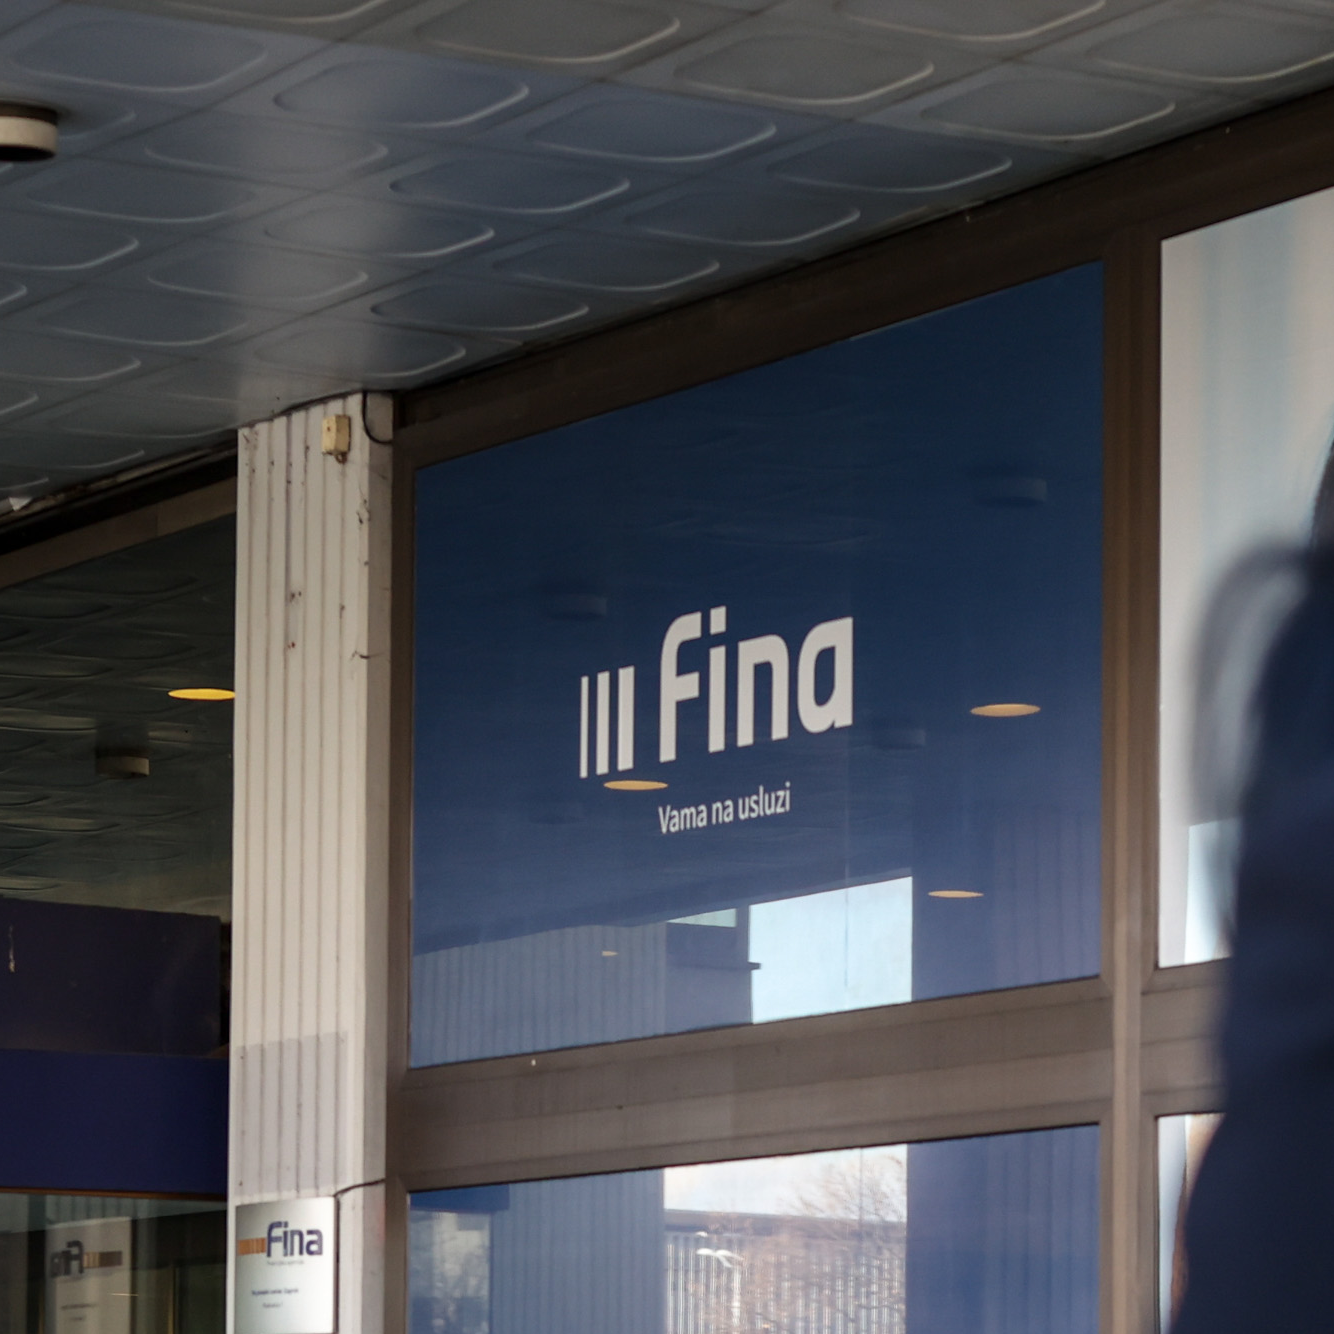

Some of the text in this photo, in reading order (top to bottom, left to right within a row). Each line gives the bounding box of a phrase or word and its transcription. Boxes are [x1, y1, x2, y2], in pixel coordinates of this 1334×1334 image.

[658, 781, 790, 834] Vama na usluzi
